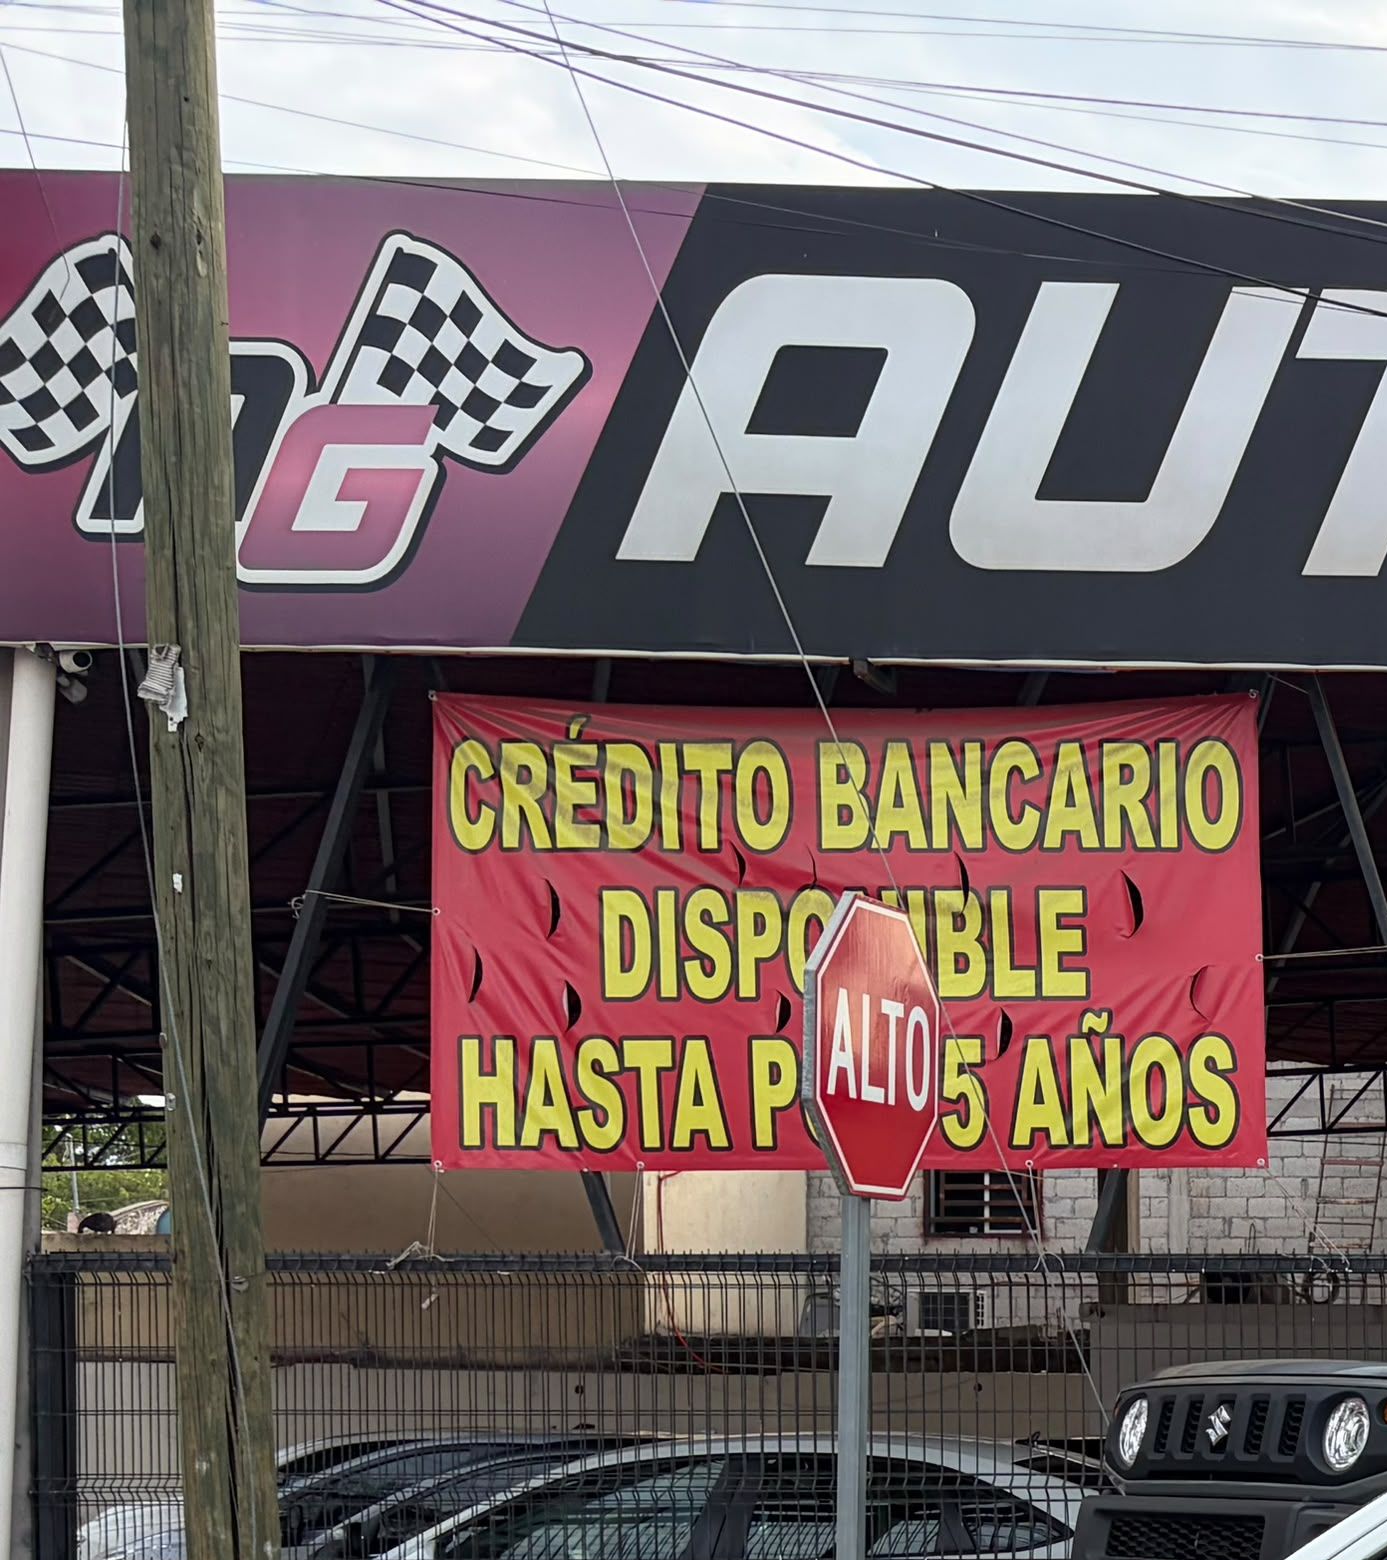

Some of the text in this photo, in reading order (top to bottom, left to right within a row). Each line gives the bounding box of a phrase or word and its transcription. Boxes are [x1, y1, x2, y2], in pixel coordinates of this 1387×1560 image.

[446, 713, 1244, 857] CRÉDITO BANCARIO
[456, 1033, 733, 1152] HASTA
[938, 1033, 990, 1152] 5
[1008, 1007, 1241, 1152] AÑOS
[826, 986, 933, 1113] ALTO
